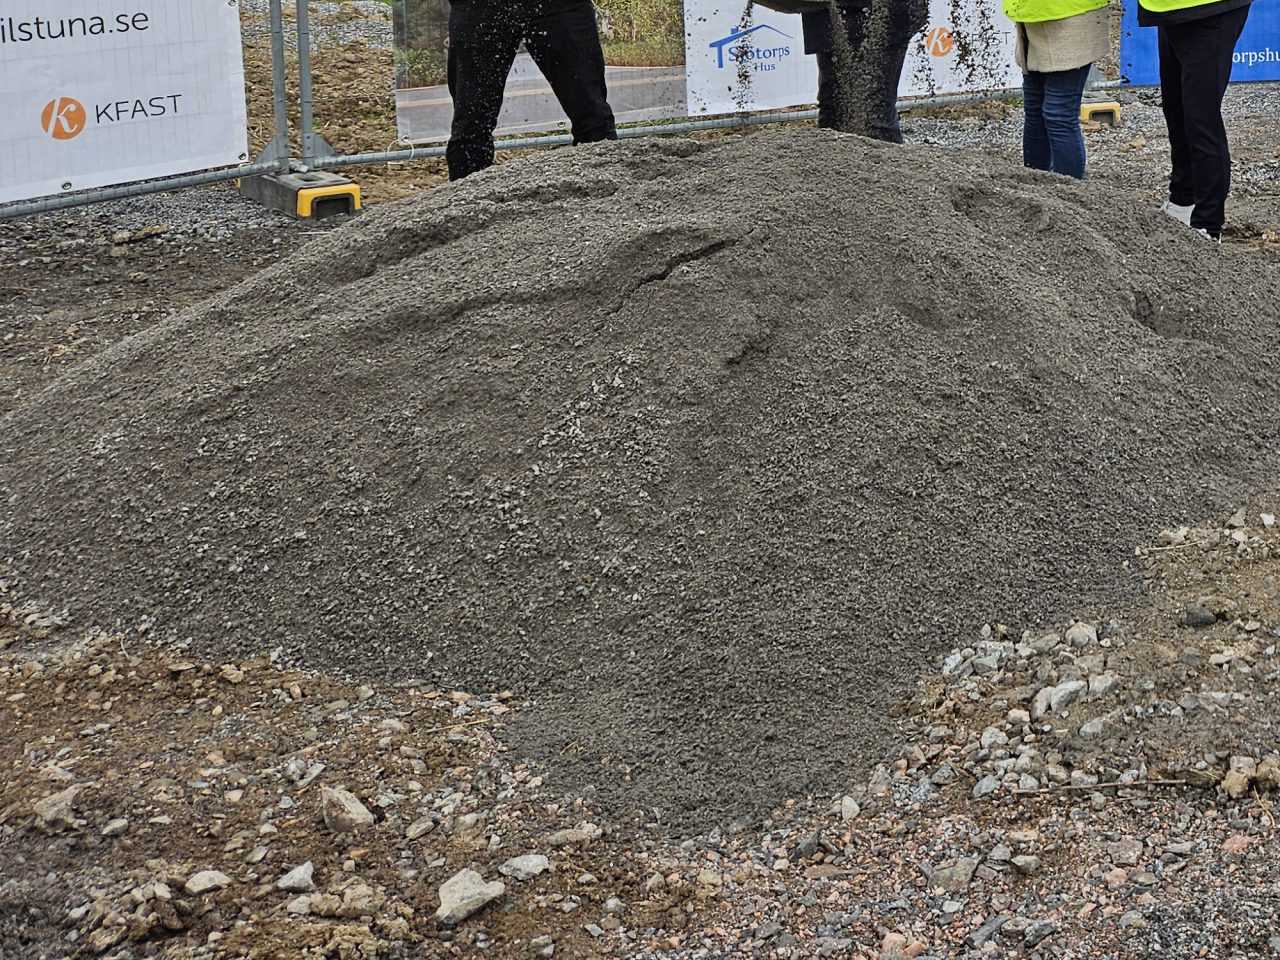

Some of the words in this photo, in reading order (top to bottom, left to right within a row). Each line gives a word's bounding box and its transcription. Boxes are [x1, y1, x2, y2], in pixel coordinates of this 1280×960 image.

[727, 44, 791, 62] Sötorps
[753, 62, 776, 72] Hus
[95, 94, 182, 124] KFAST
